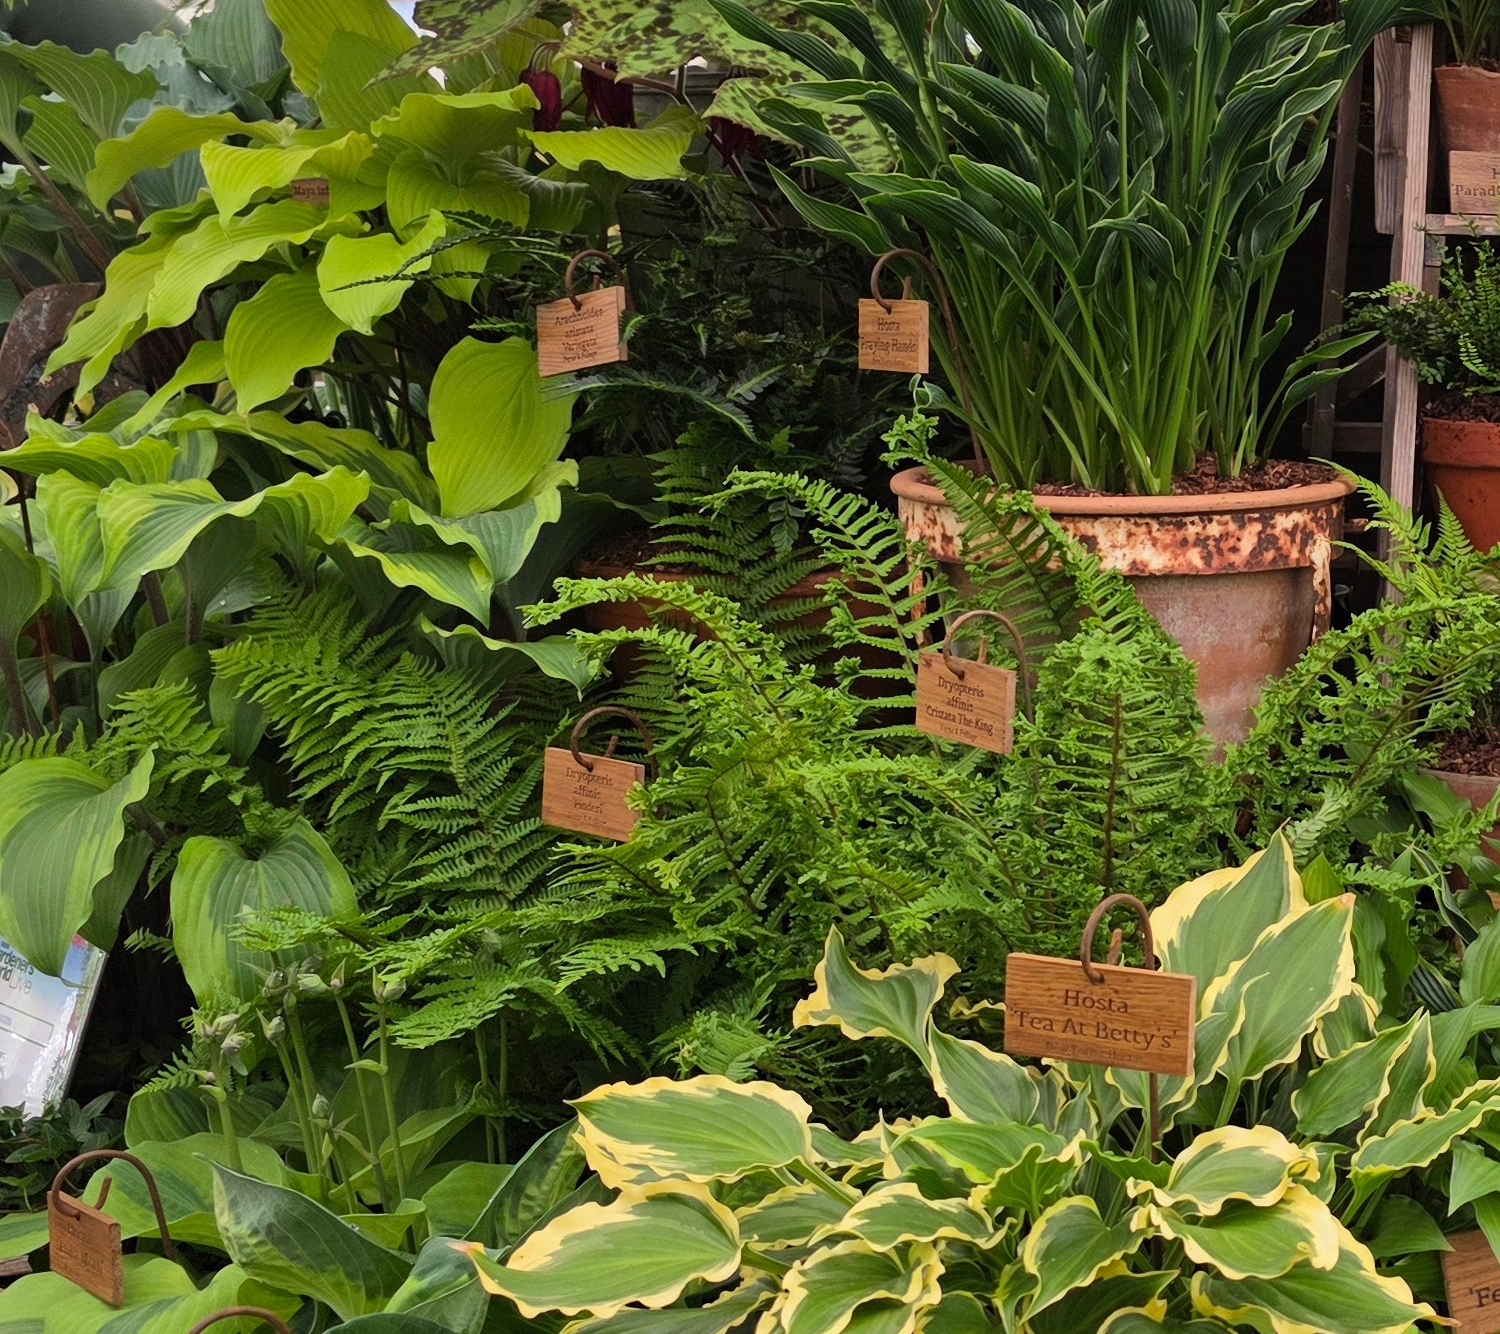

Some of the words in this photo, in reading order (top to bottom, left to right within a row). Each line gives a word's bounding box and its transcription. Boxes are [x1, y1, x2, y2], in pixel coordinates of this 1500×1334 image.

[877, 317, 900, 331] Hosta
[938, 676, 985, 698] Dryopteris
[946, 696, 974, 712] affinis
[958, 713, 974, 727] The
[566, 766, 614, 786] Dryopteris
[1064, 989, 1129, 1014] Hosta
[1010, 1006, 1054, 1032] 'Tea
[1062, 1018, 1088, 1036] At
[1094, 1021, 1178, 1051] Betty's'
